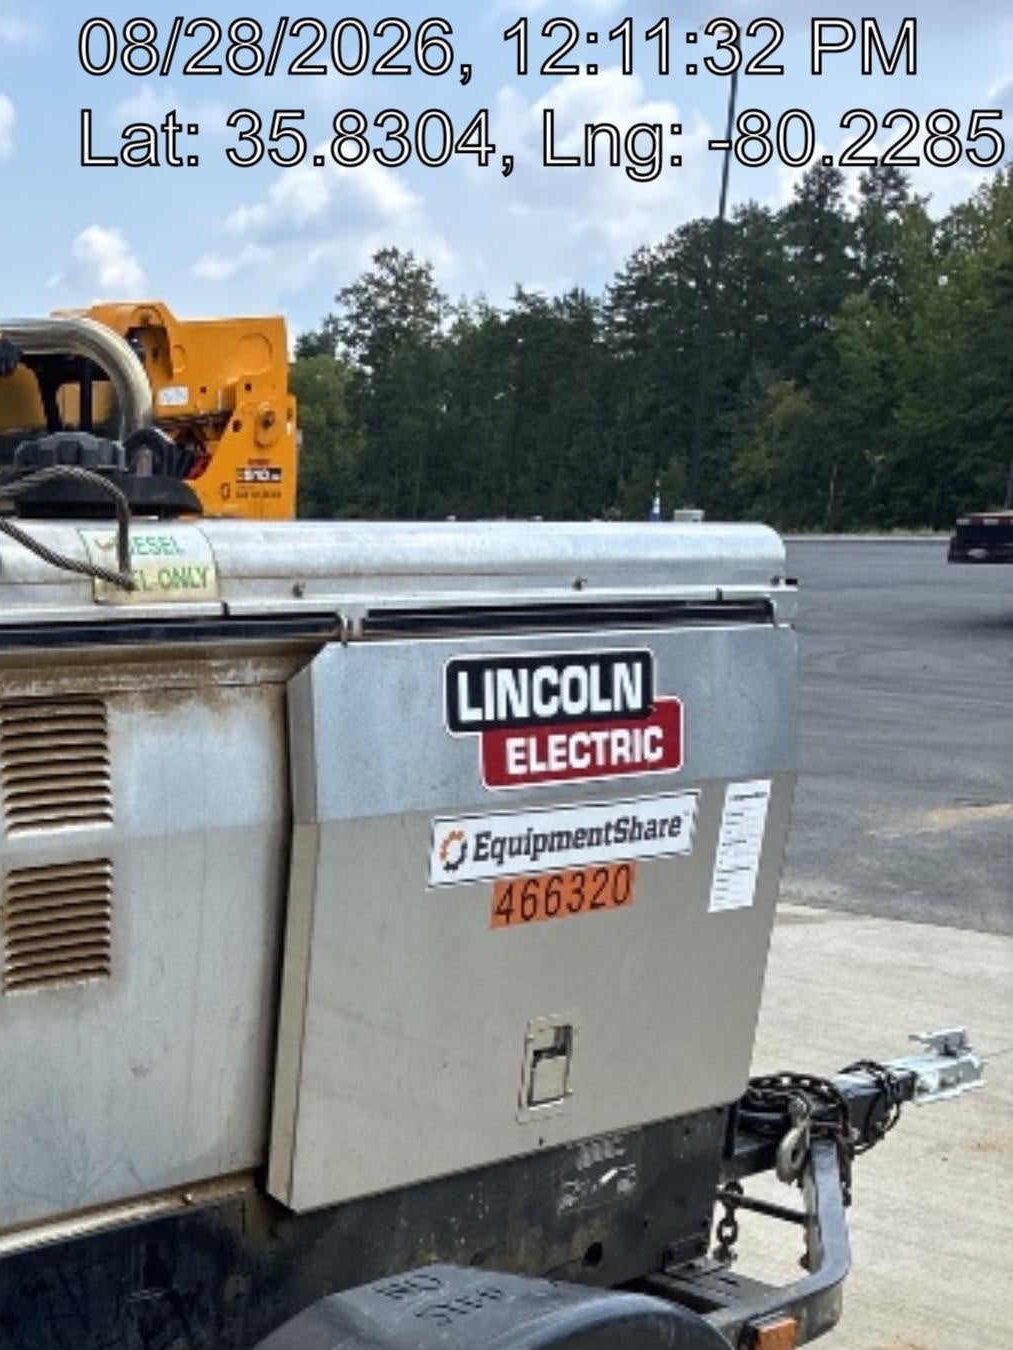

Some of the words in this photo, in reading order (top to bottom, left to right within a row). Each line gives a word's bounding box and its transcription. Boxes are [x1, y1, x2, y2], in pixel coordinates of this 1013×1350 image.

[158, 565, 209, 589] ONLY
[458, 662, 643, 722] LINCOLN
[505, 725, 664, 776] ELECTRIC
[473, 813, 682, 866] EquipmentShare
[496, 864, 631, 924] 466320
